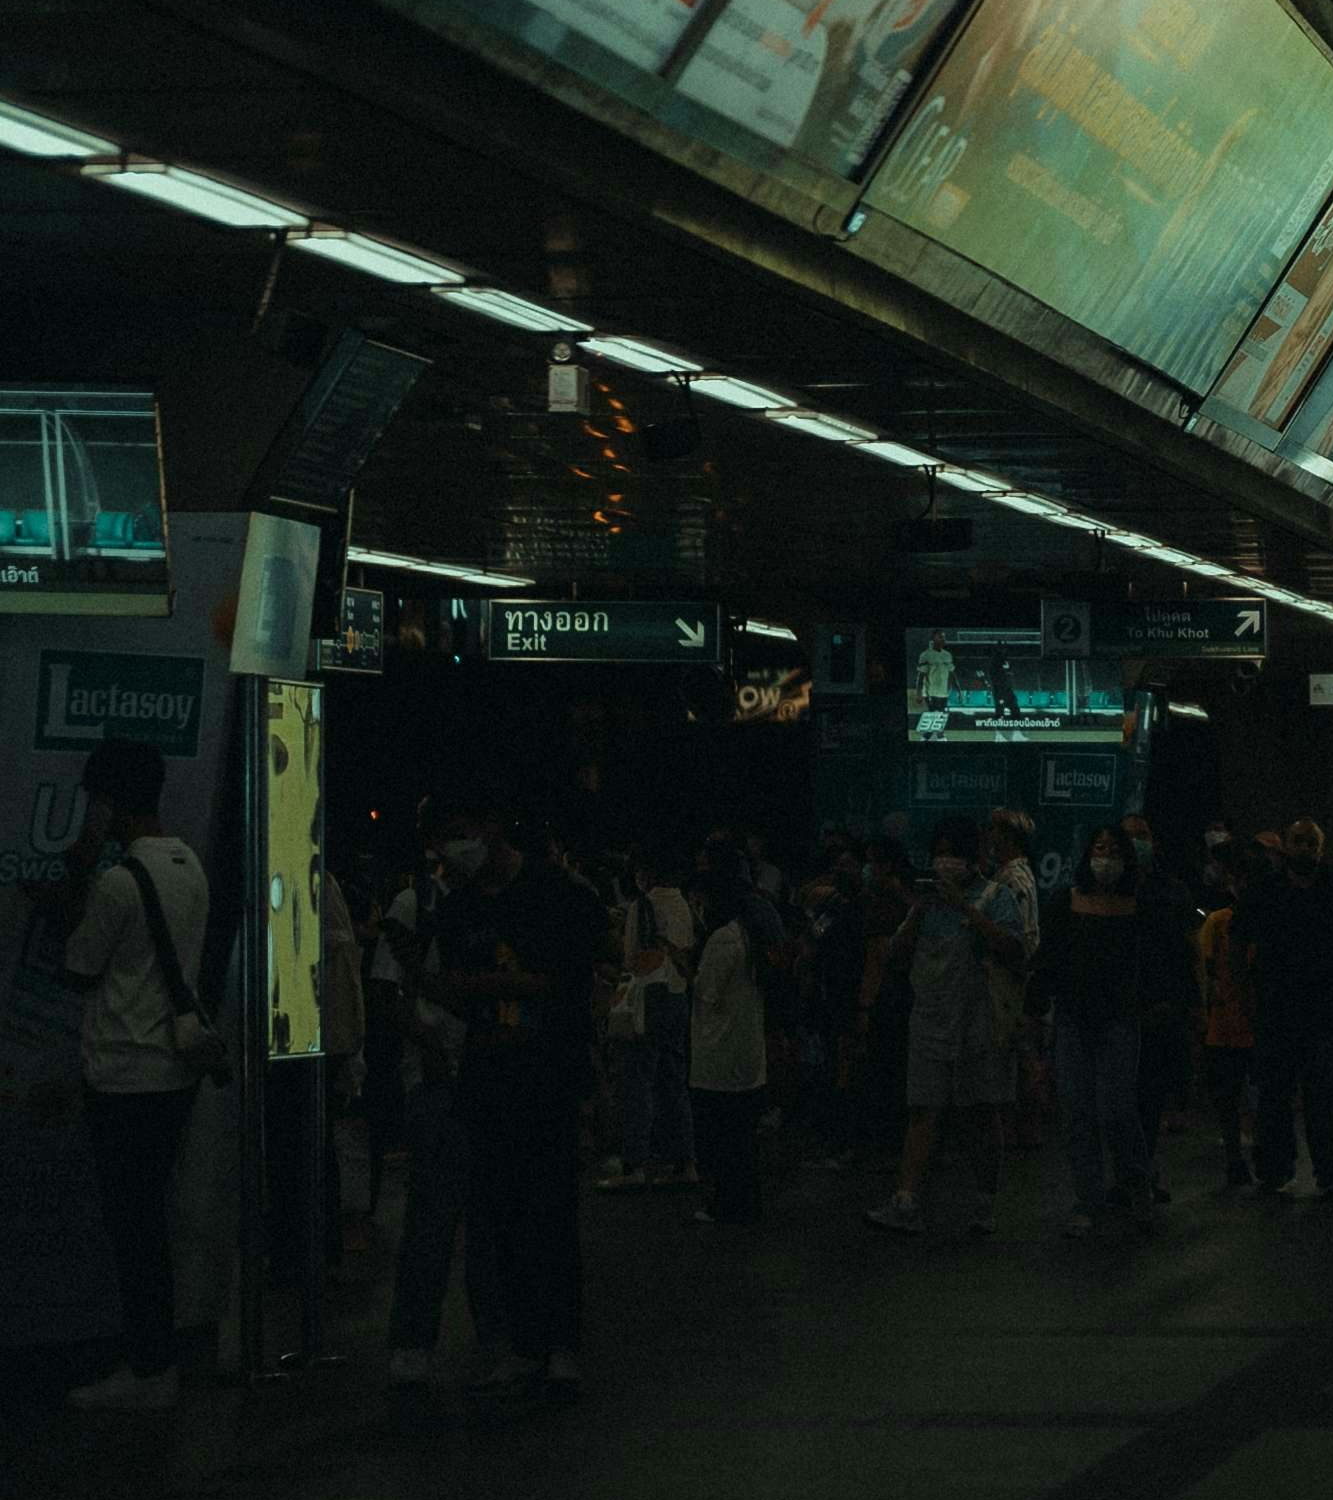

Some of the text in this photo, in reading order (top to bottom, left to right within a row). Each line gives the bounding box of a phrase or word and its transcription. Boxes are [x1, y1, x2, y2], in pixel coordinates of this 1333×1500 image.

[503, 606, 610, 633] ทางออก
[505, 632, 548, 653] Exit
[1127, 627, 1211, 640] To Khu Khot
[43, 663, 196, 740] Lactasoy
[1045, 760, 1112, 798] Lactasoy
